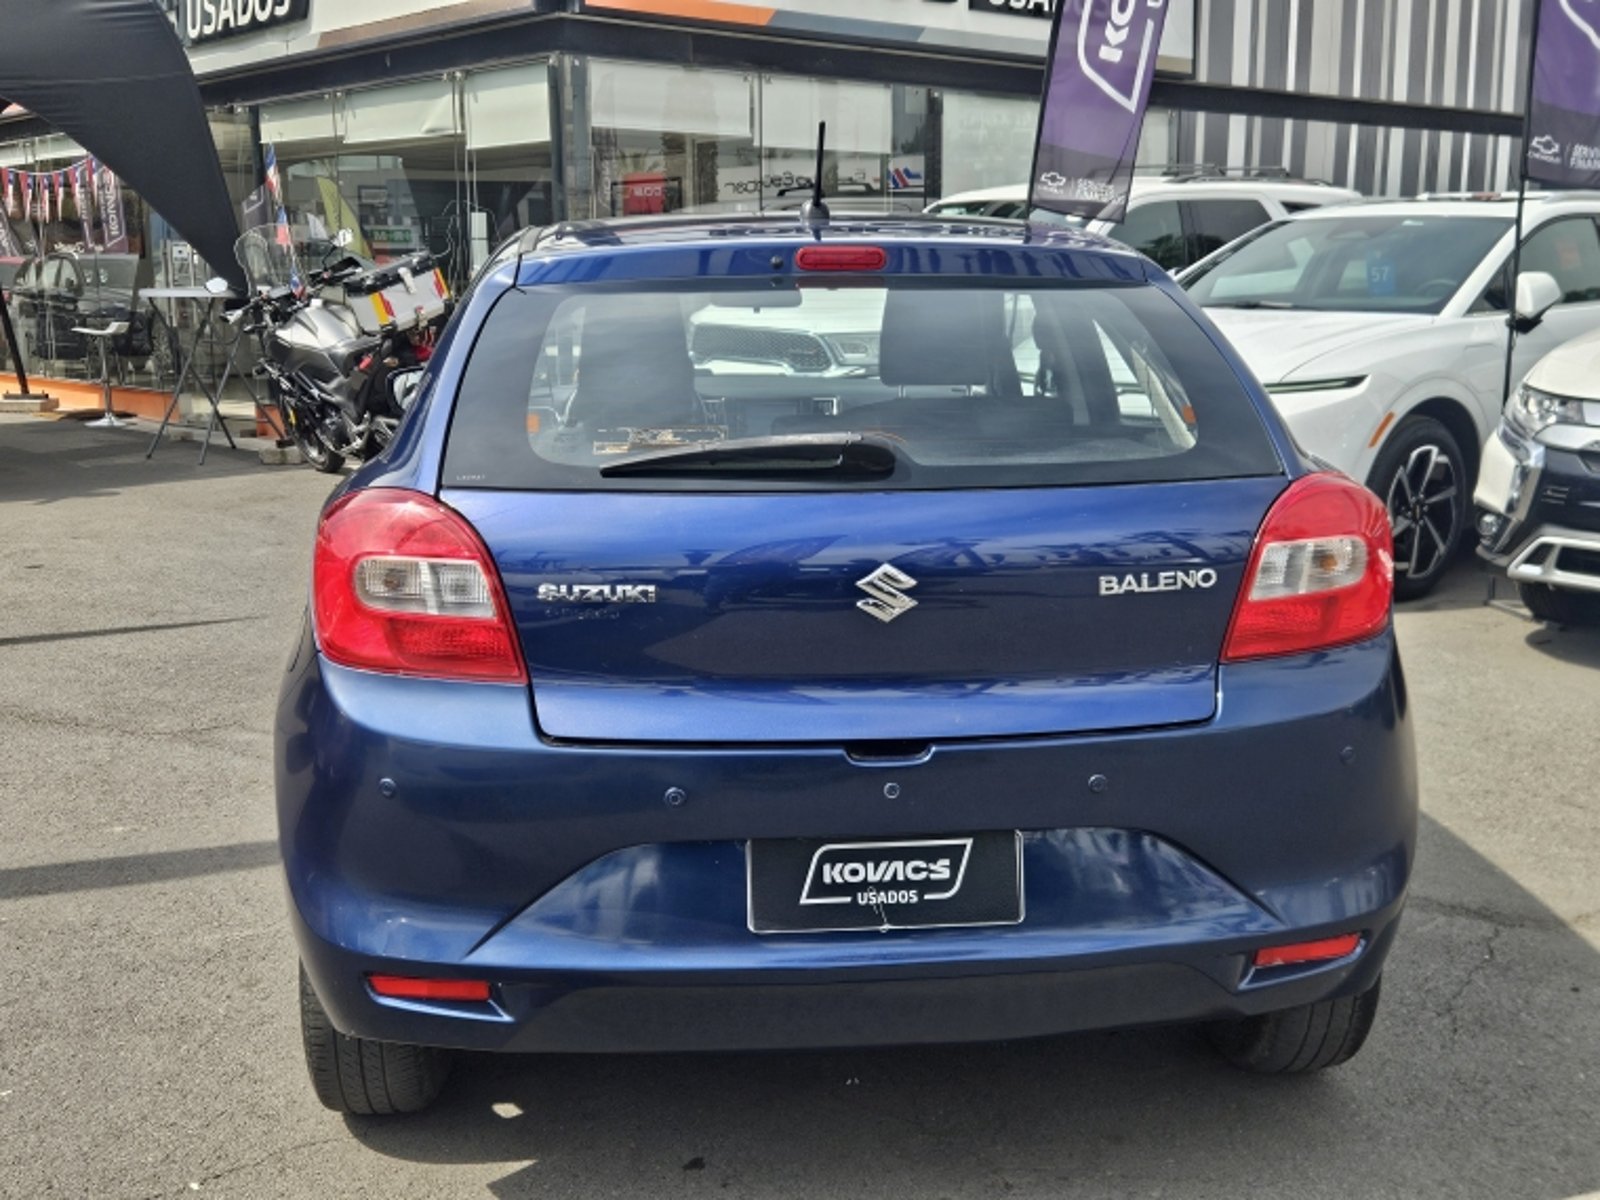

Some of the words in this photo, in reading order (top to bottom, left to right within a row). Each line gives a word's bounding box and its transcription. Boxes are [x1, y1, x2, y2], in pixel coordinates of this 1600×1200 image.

[1371, 266, 1390, 282] 57
[1099, 568, 1218, 596] BALENO
[537, 583, 656, 603] SUZUKI
[821, 858, 951, 885] KOVACS
[856, 890, 919, 906] USADOS
